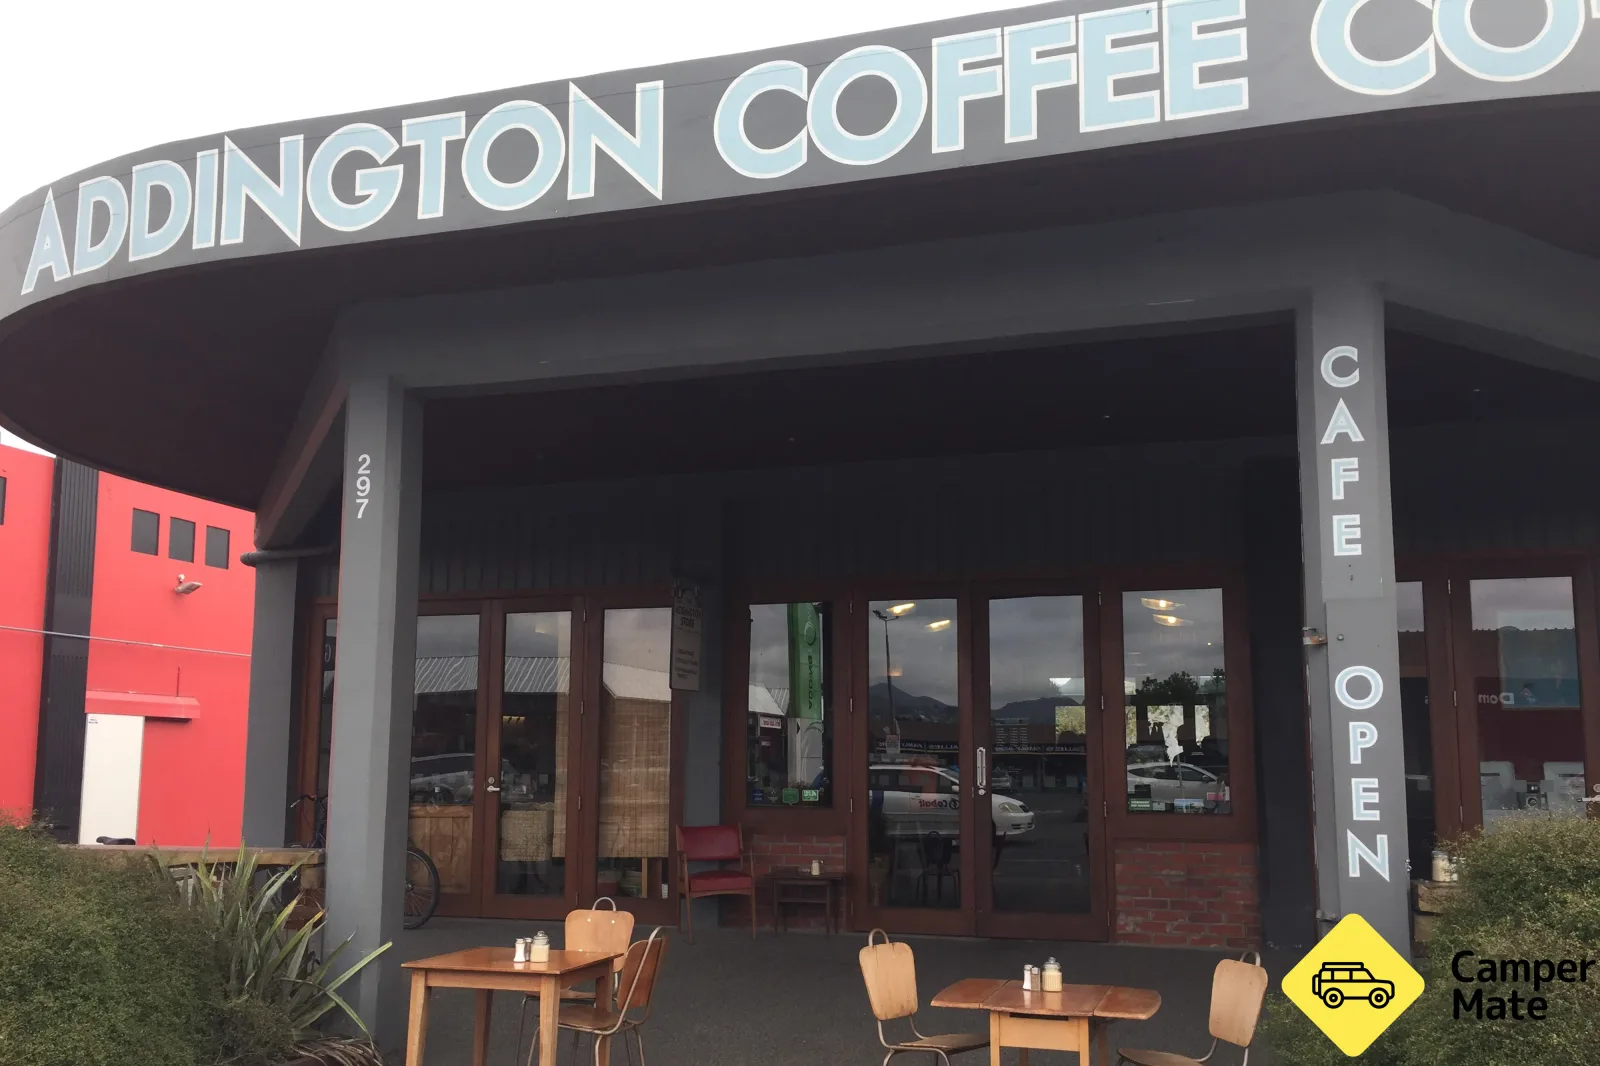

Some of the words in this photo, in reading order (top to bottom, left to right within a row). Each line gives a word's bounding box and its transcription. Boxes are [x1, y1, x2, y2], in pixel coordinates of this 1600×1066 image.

[21, 79, 664, 296] ADDINGTON
[713, 0, 1249, 180] COFFEE
[1309, 0, 1600, 97] CO
[355, 453, 372, 519] 297
[1319, 345, 1365, 557] CAFE
[1334, 665, 1390, 883] OPEN
